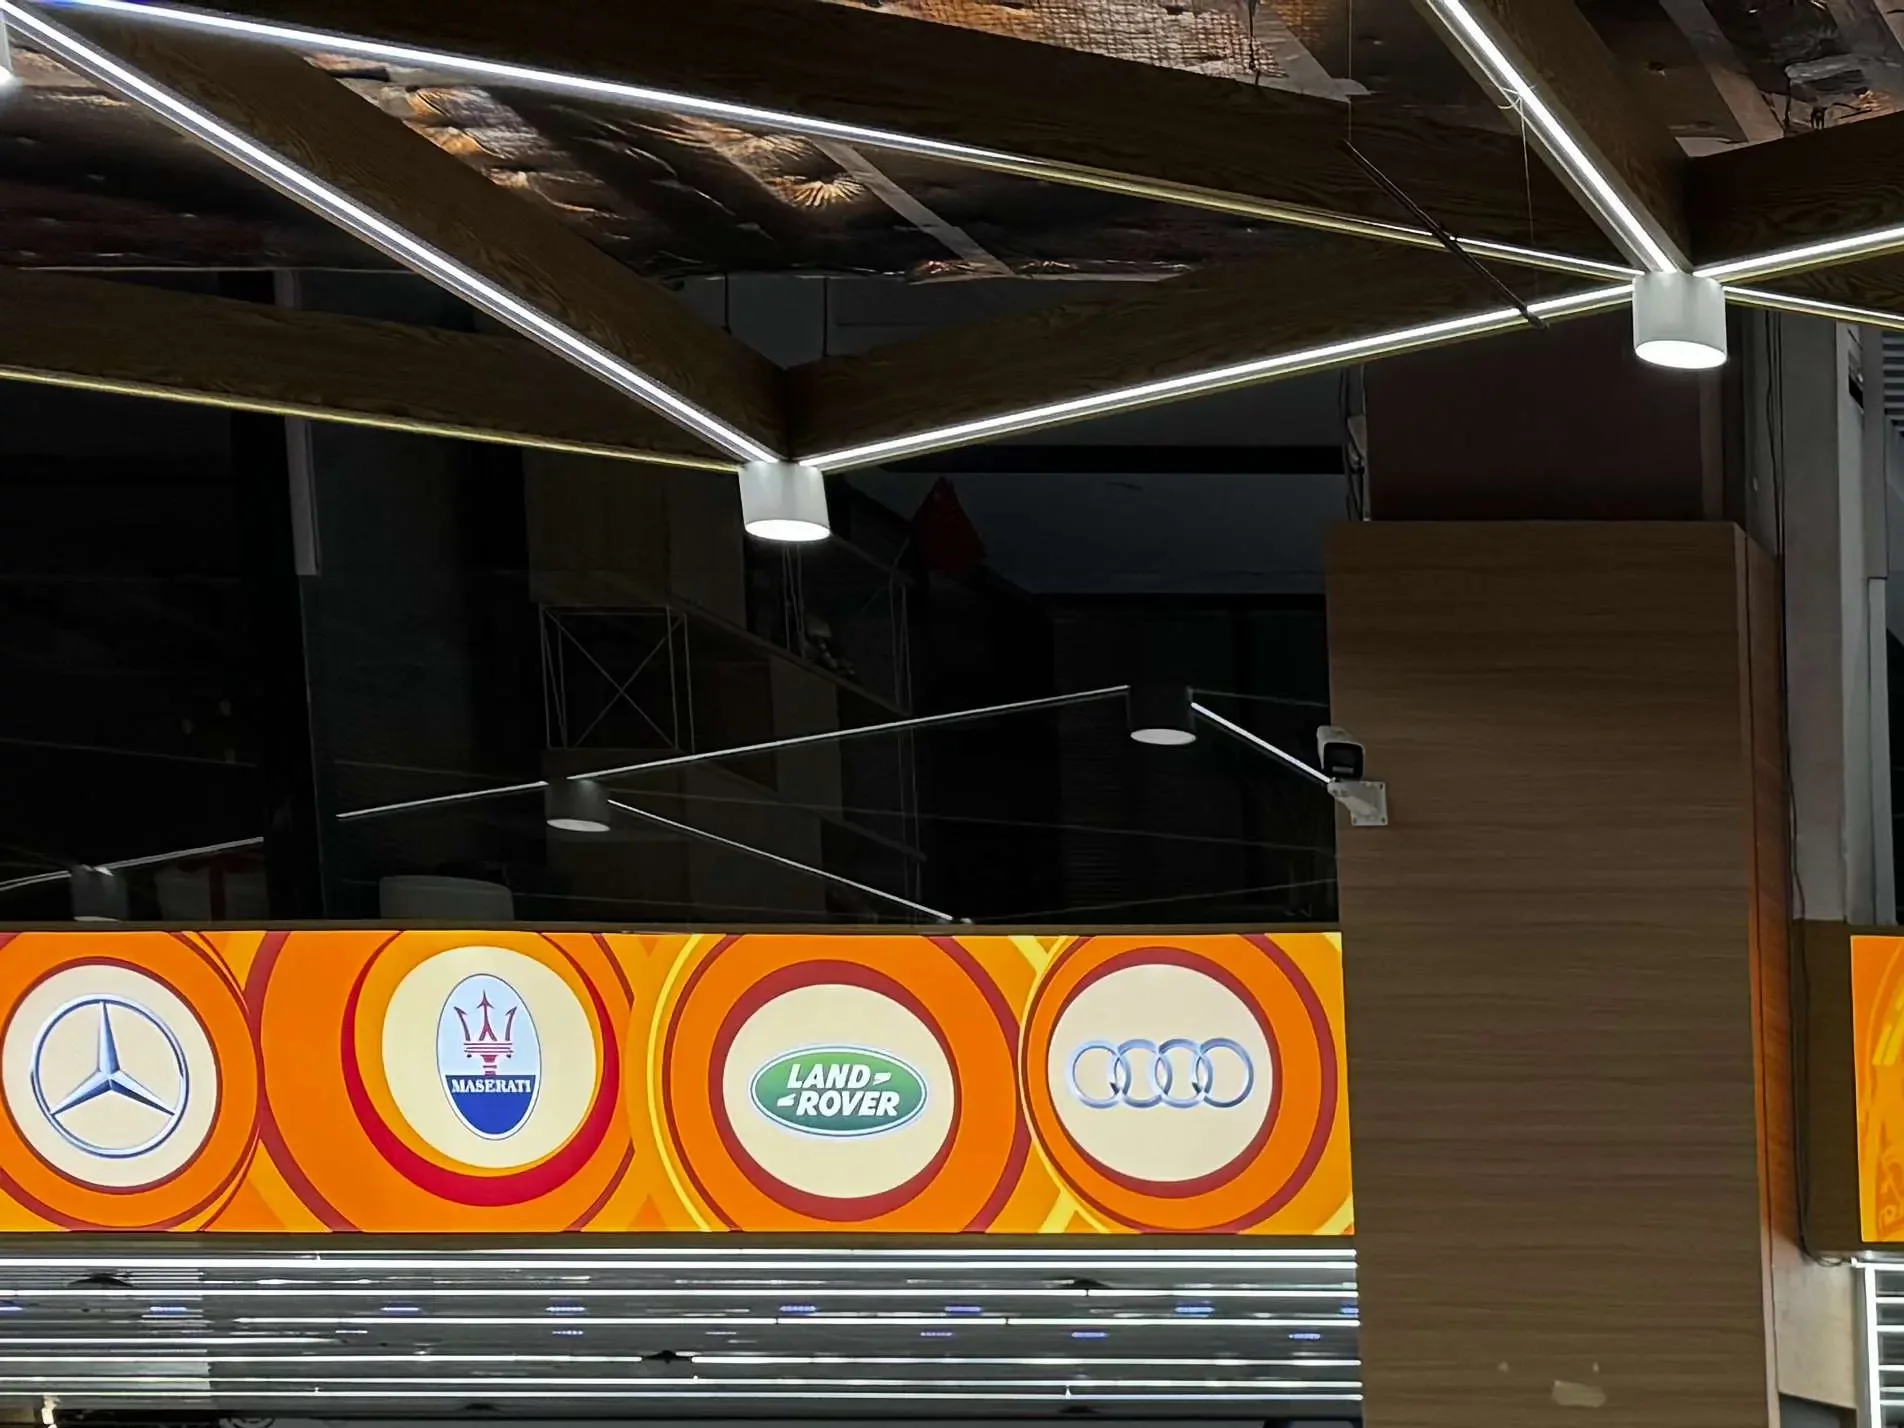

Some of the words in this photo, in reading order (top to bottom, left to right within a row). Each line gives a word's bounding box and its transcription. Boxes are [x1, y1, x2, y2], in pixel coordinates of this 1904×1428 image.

[451, 1078, 532, 1094] MASERATI
[787, 1064, 869, 1087] LAND
[796, 1091, 900, 1117] ROVER
